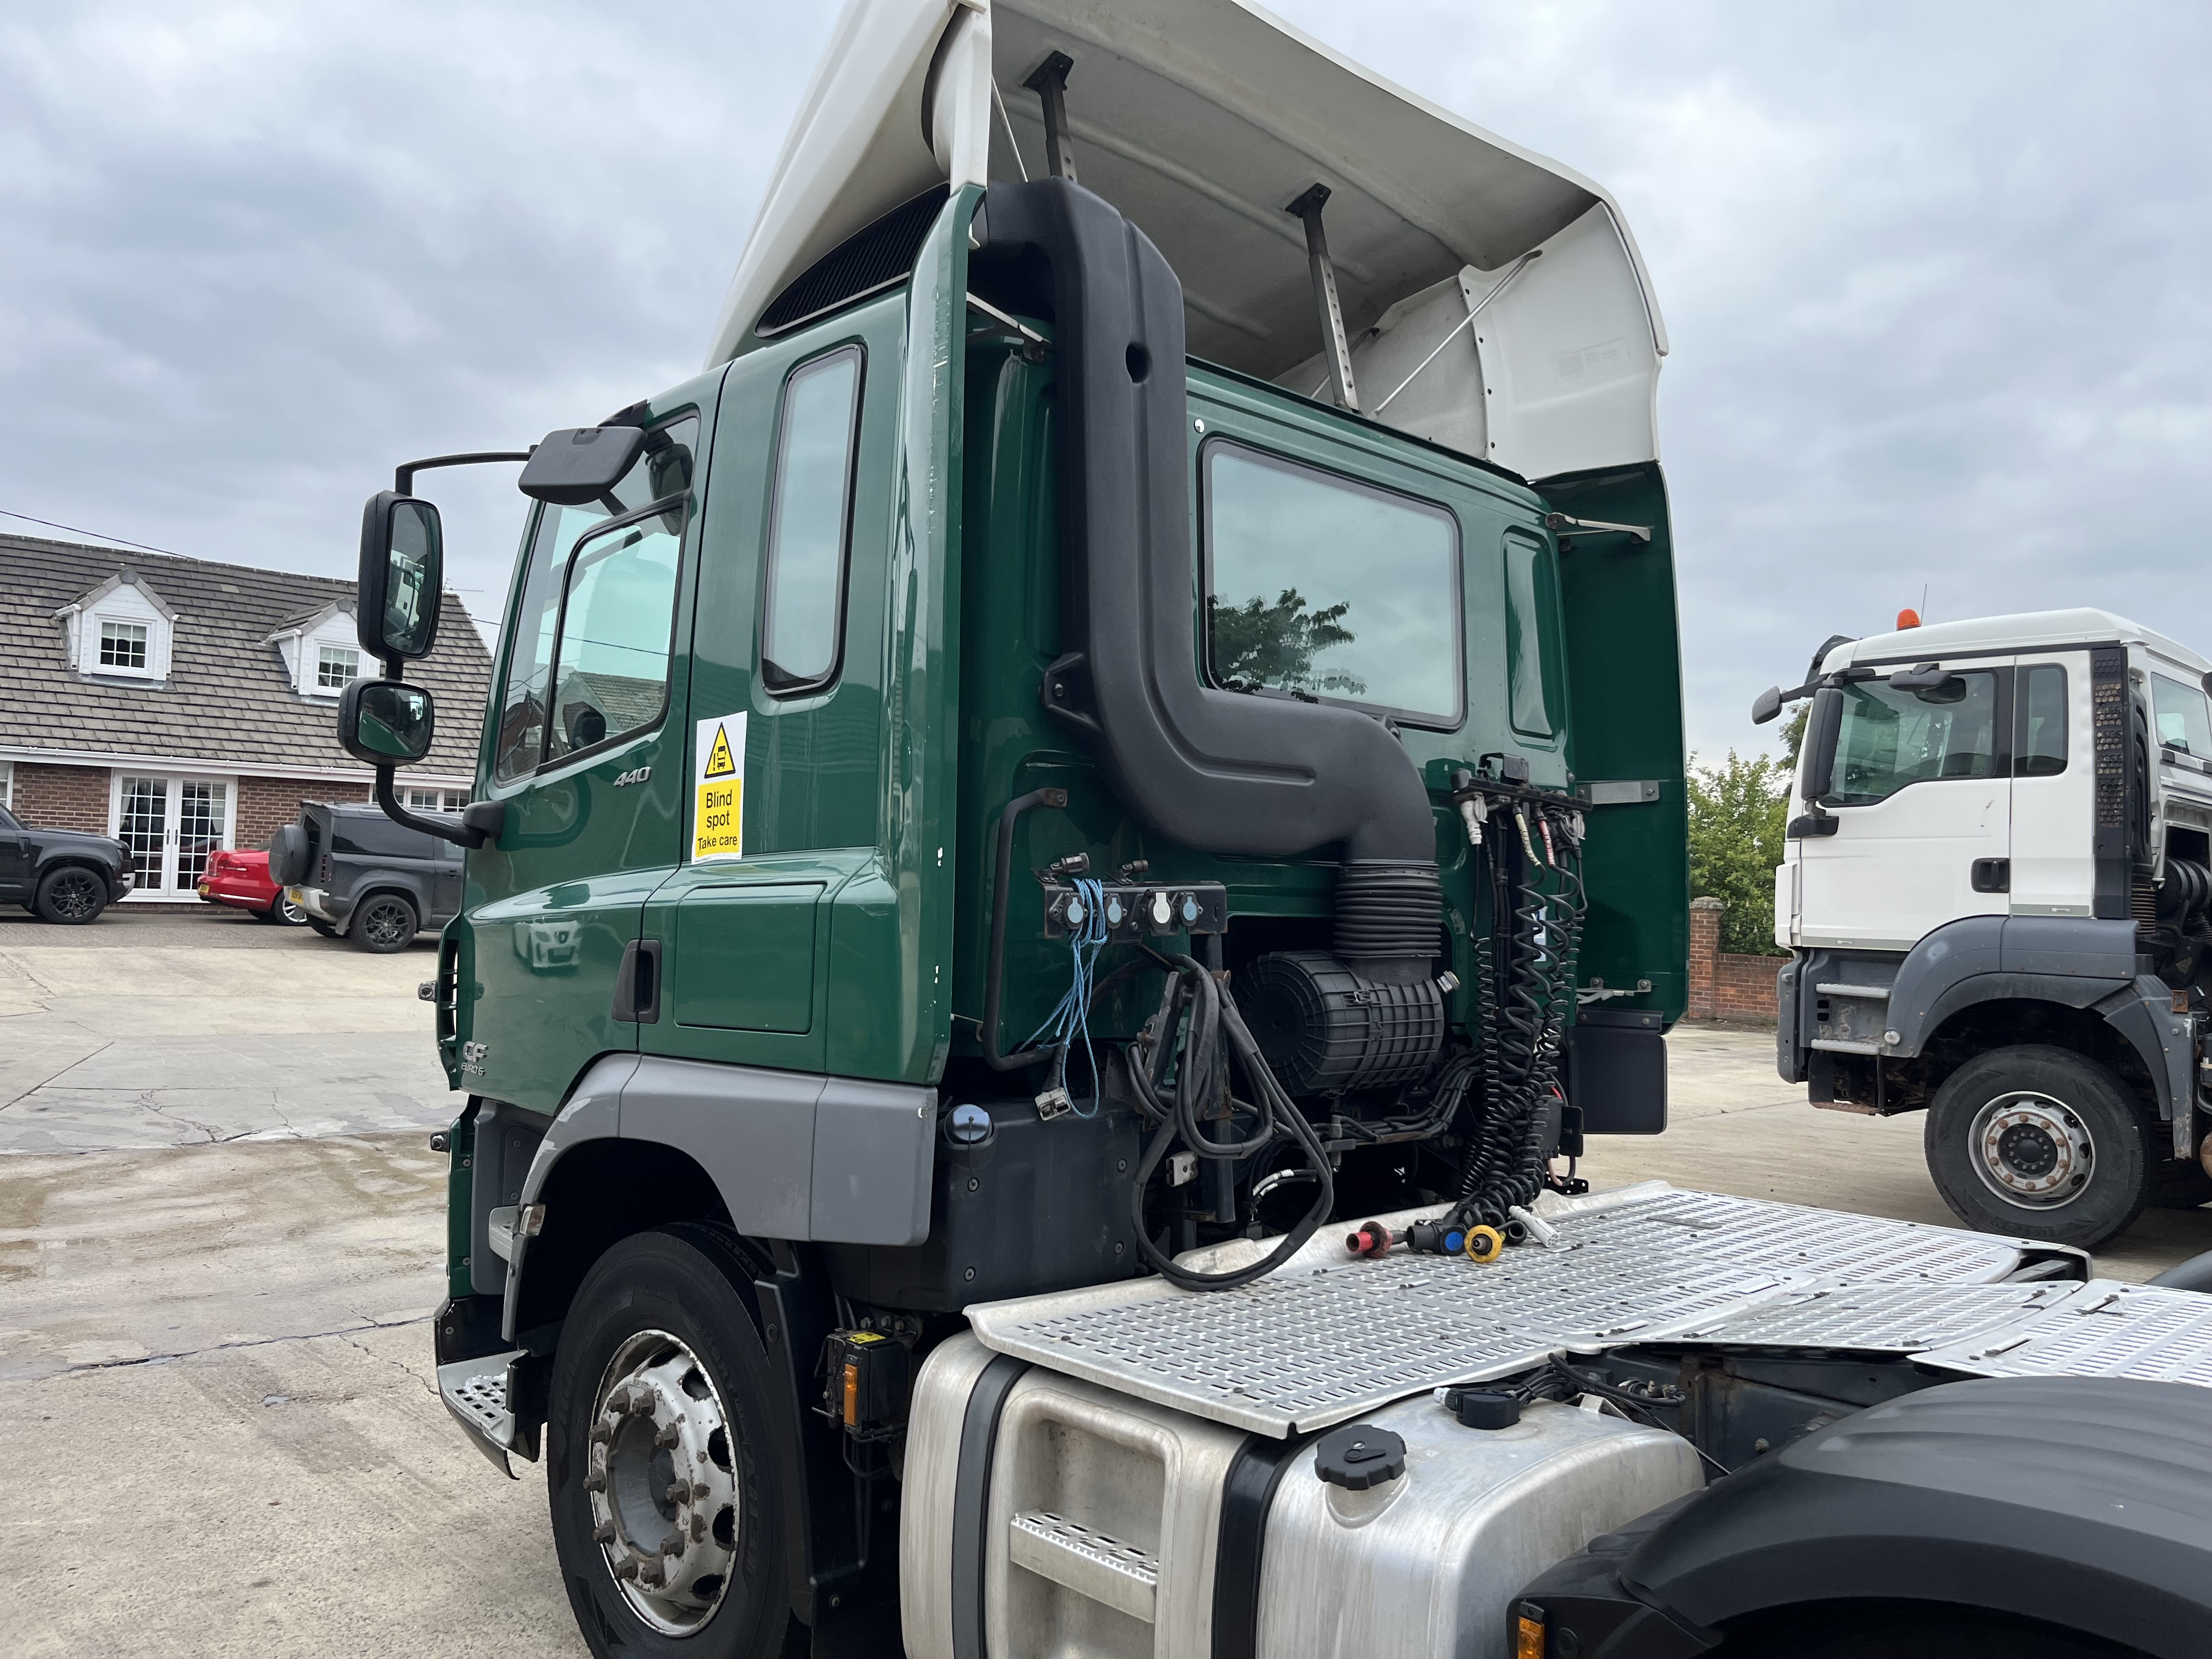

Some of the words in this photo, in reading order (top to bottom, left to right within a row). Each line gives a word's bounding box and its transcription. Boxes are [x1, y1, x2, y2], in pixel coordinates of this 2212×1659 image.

[613, 766, 652, 787] 440
[707, 789, 732, 809] Blind
[707, 810, 730, 830] spot
[698, 836, 716, 850] Take
[719, 835, 737, 846] care
[463, 1041, 489, 1062] CF
[461, 1062, 478, 1074] EURO
